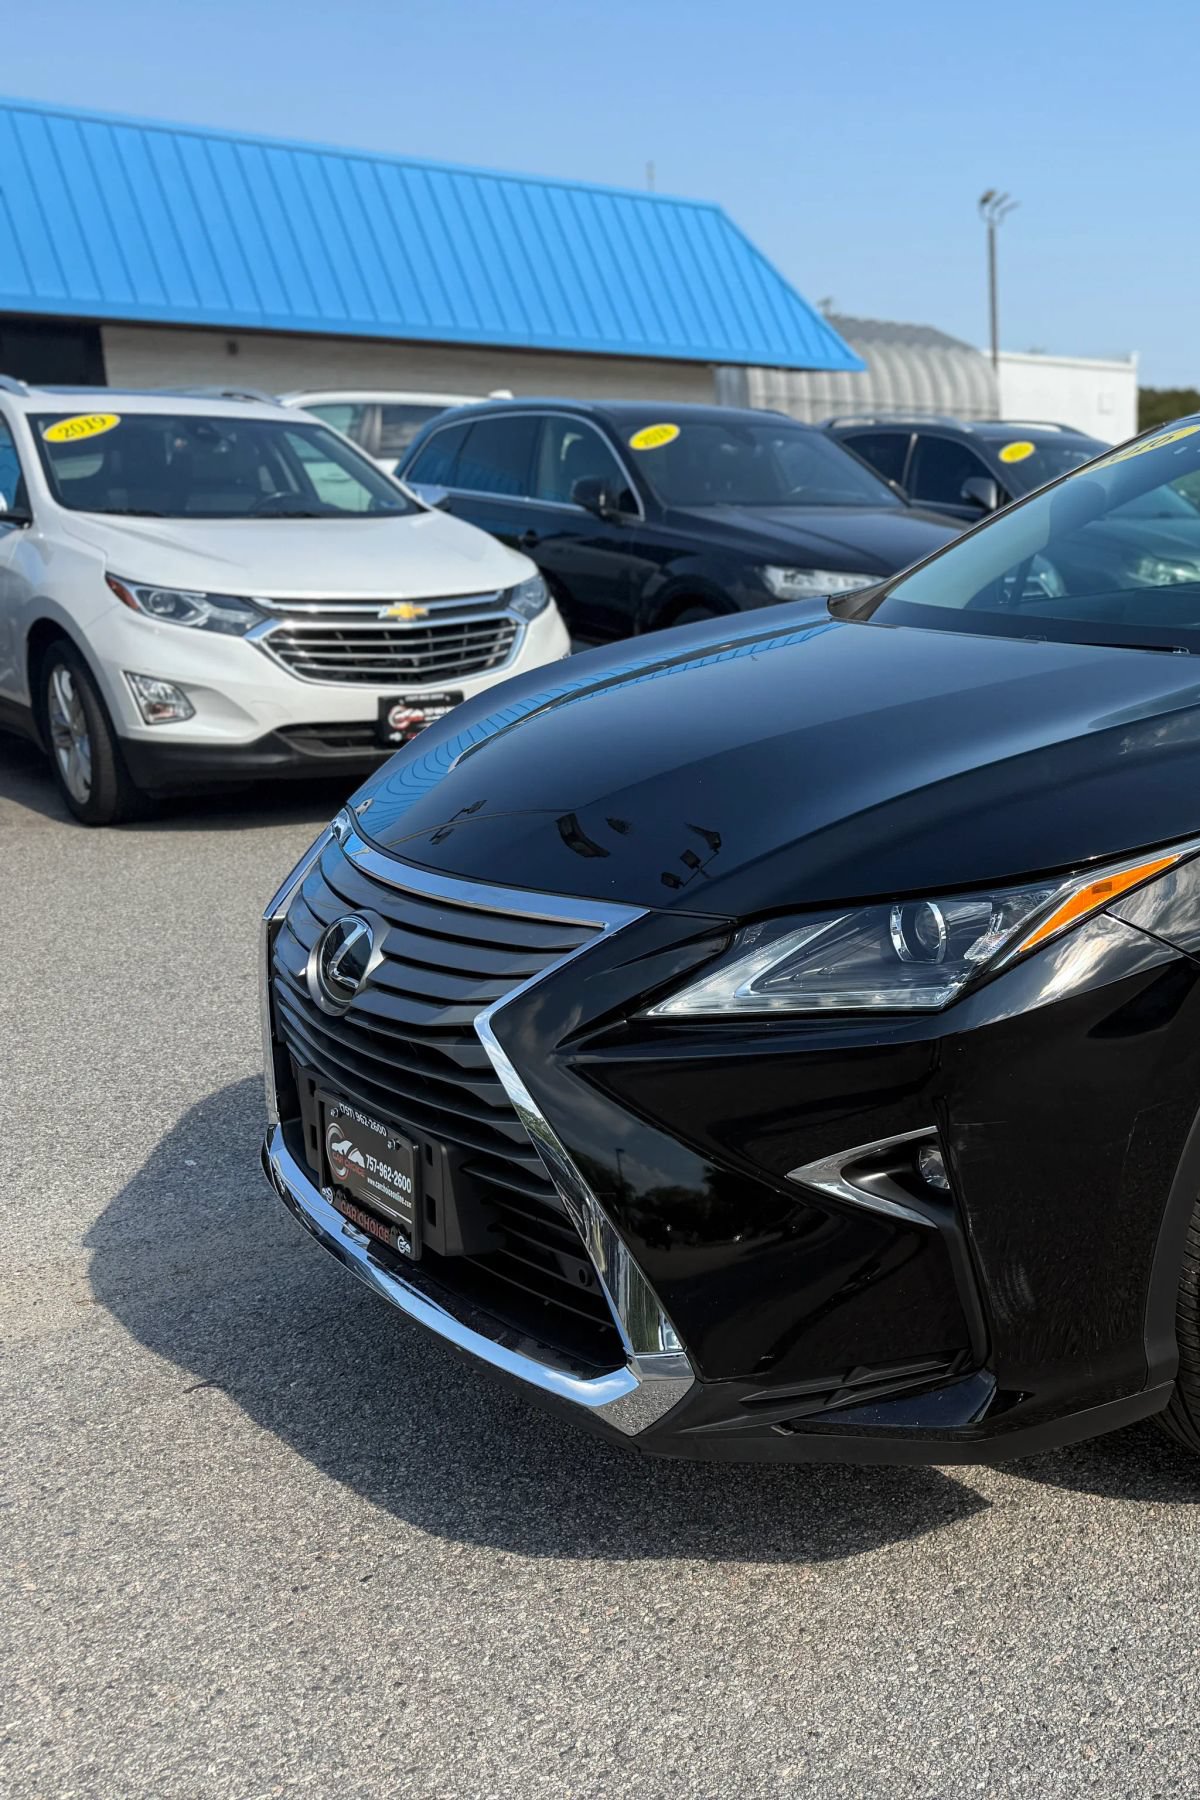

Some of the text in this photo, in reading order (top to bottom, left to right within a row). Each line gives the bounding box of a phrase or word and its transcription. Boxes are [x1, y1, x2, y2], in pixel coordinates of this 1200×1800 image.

[57, 415, 107, 439] 2019
[365, 1153, 412, 1194] 757-962-2600
[340, 1200, 392, 1244] CAR CHOICE
